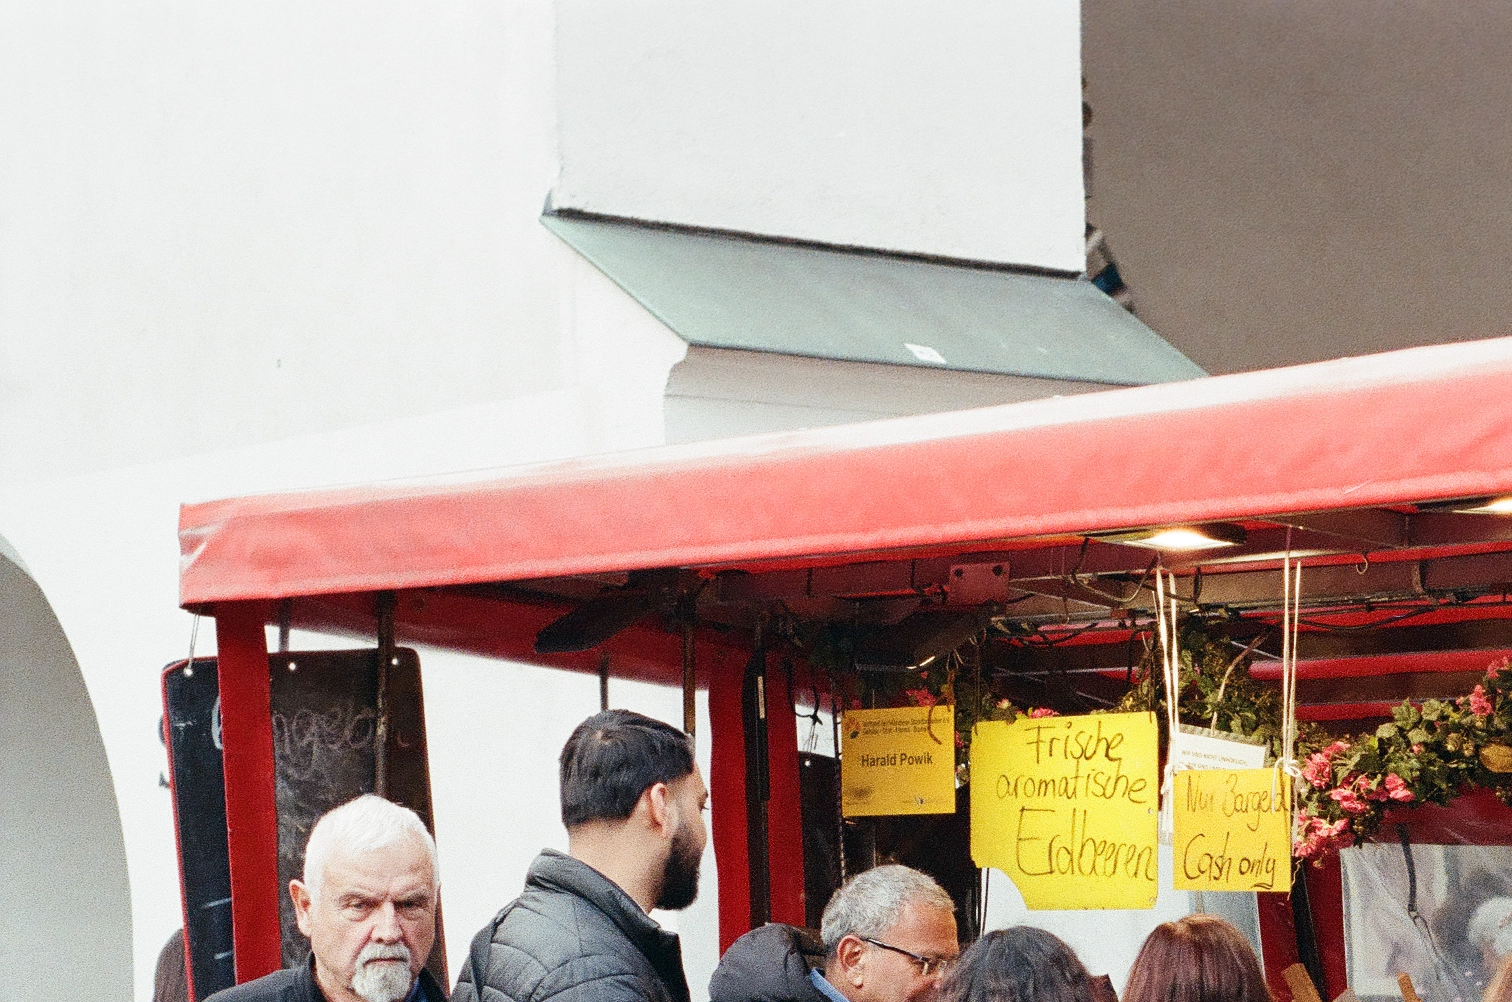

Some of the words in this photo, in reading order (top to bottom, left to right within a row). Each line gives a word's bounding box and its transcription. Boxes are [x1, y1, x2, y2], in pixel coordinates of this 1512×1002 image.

[861, 753, 897, 767] Harald
[900, 752, 934, 766] Powik
[1025, 720, 1124, 764] Frische
[996, 758, 1148, 804] aromatische
[1186, 774, 1214, 813] Nur
[1221, 769, 1289, 832] Bargeld
[1015, 806, 1156, 881] Erdbeeren
[1183, 831, 1232, 883] Cash
[1239, 841, 1276, 889] only
